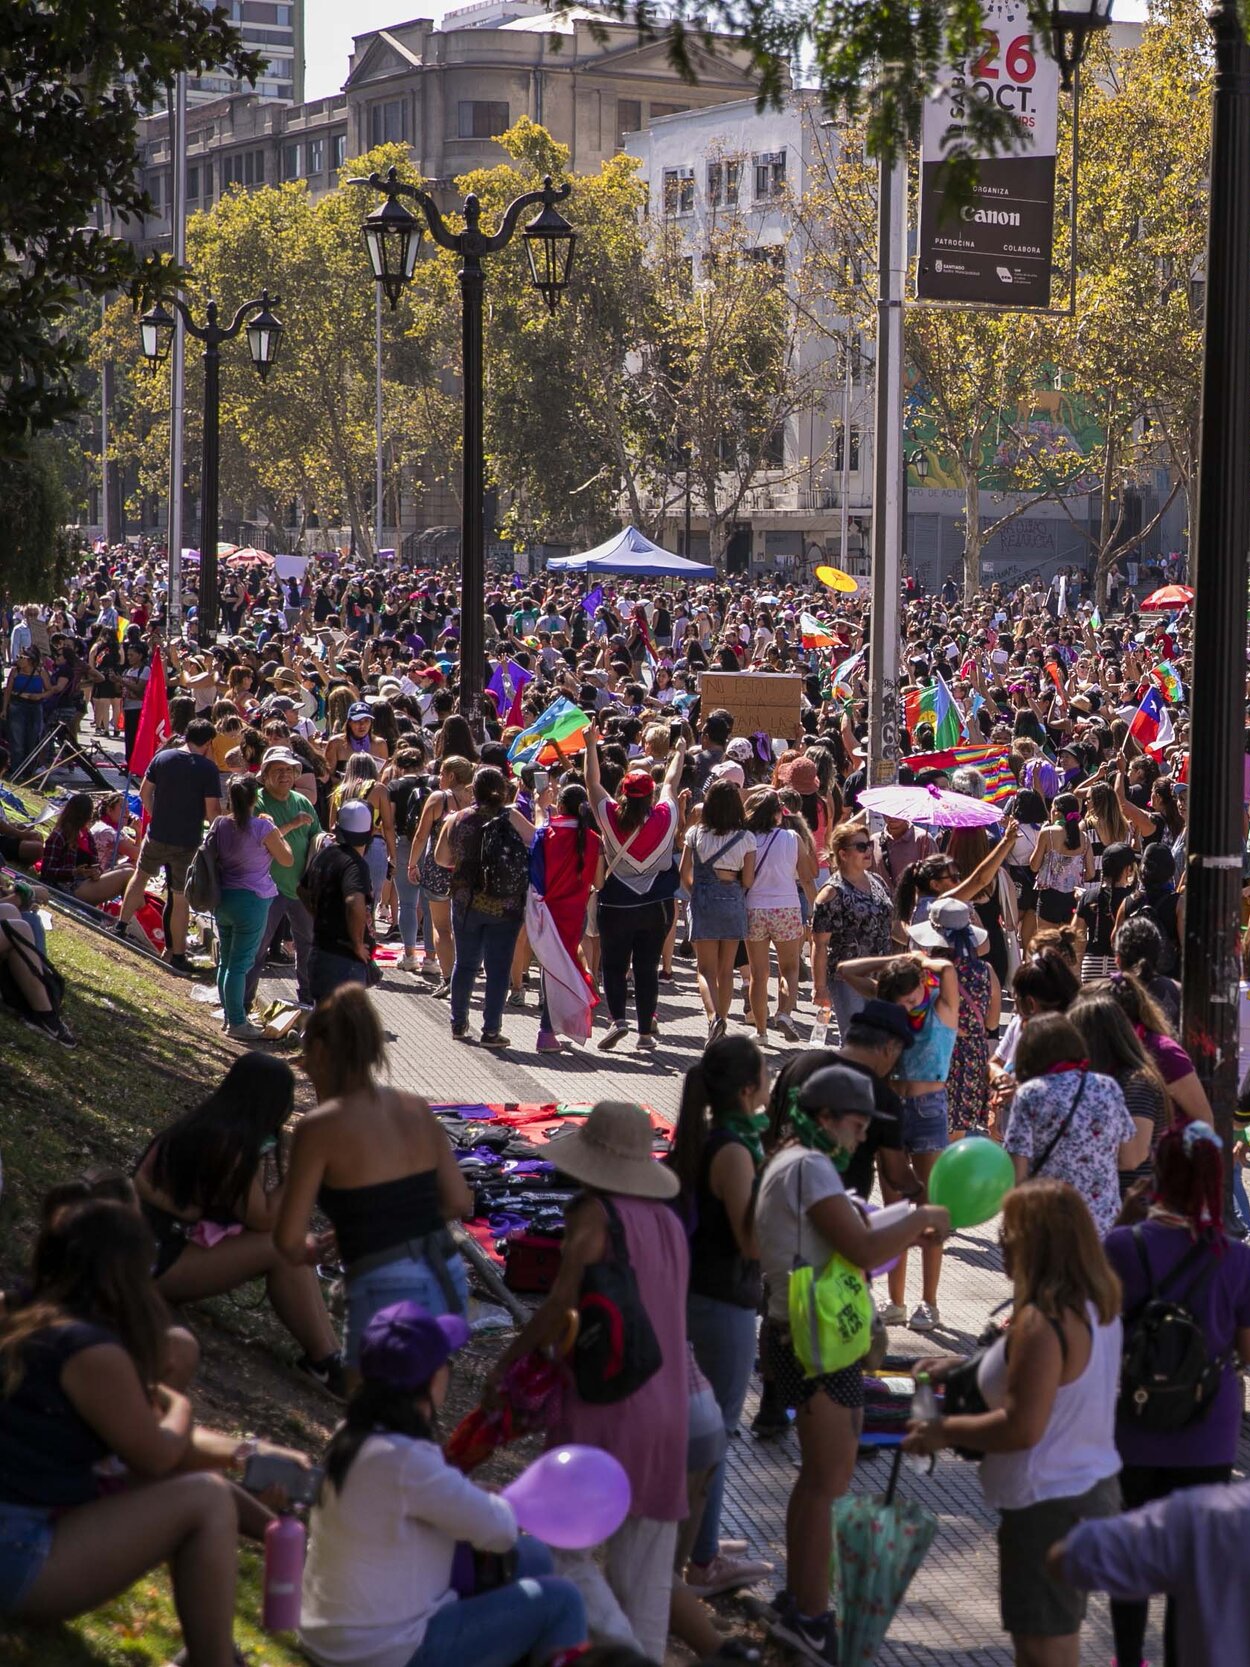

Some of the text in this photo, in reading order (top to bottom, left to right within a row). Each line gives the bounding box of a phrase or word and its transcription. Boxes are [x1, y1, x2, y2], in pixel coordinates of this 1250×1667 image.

[969, 28, 1036, 84] 26
[971, 81, 1036, 113] OCT.
[972, 185, 1009, 195] ORGANIZA
[960, 205, 1020, 226] Canon
[934, 237, 975, 248] PATROCINA
[1003, 244, 1041, 254] COLABORA
